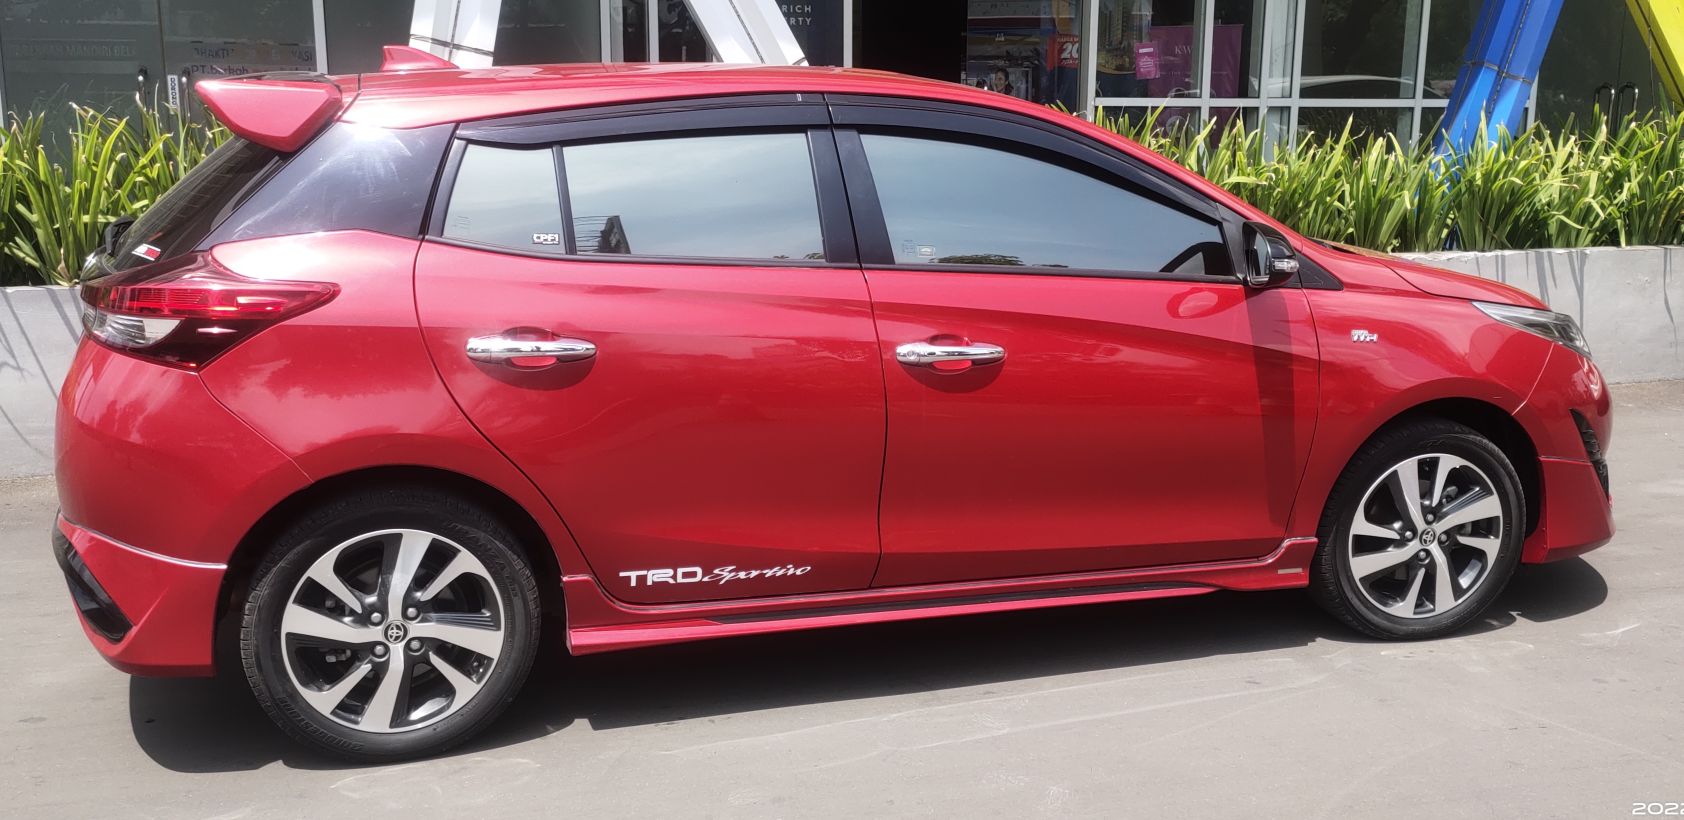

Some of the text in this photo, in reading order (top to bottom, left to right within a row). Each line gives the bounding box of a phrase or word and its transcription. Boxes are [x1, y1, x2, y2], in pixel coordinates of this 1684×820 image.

[785, 17, 812, 26] RTY
[618, 564, 812, 587] TRD Sportivo
